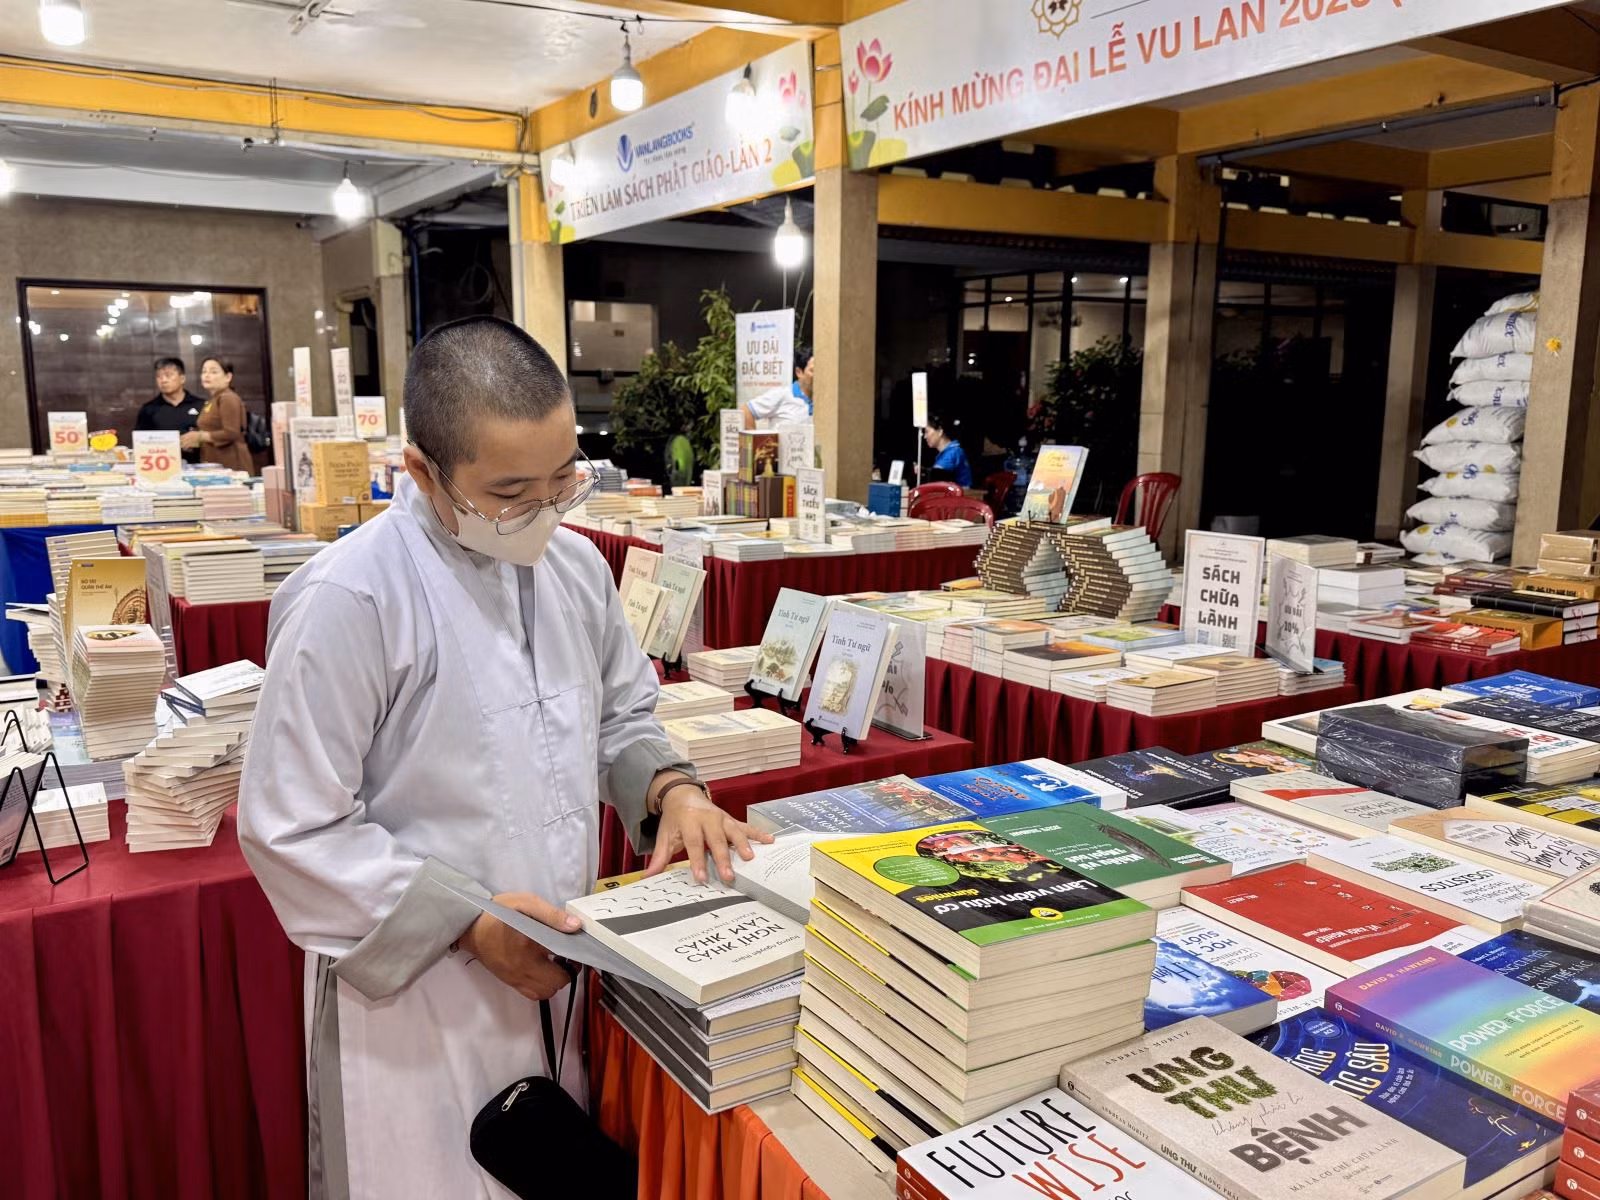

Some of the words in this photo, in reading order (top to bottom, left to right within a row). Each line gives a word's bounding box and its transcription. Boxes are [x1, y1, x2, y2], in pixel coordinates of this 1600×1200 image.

[894, 89, 944, 131] KÍNH
[951, 68, 1024, 115] MỪNG
[1033, 51, 1079, 94] ĐẠI
[1089, 21, 1127, 78] LỄ
[1136, 21, 1181, 64] VU
[1194, 0, 1266, 50] LAN
[624, 173, 654, 205] SÁCH
[763, 138, 773, 164] 2
[1202, 564, 1240, 584] SÁCH
[1200, 587, 1239, 608] CHỮA
[1198, 610, 1238, 631] LÀNH
[1054, 879, 1098, 896] Làm
[1419, 868, 1502, 893] LOGISTICS
[915, 887, 980, 903] dummies
[962, 894, 1003, 911] hữu
[1005, 885, 1053, 905] vườn
[933, 901, 961, 916] cơ
[728, 915, 771, 936] LÀM
[738, 922, 786, 948] NGHĨ
[1181, 930, 1220, 946] SUỐT
[1359, 973, 1387, 991] DAVID
[1399, 955, 1436, 976] HAWKINS
[1375, 1022, 1398, 1037] DAVID
[1448, 1018, 1511, 1052] POWER
[1509, 996, 1566, 1024] FORCE
[1104, 1047, 1150, 1066] ANDREAS
[1153, 1030, 1191, 1048] MORITZ
[1126, 1046, 1235, 1093] UNG
[1451, 1055, 1504, 1091] POWER
[1512, 1086, 1567, 1122] FORCE
[926, 1098, 1096, 1188] FUTURE
[1101, 1106, 1126, 1125] ANDREAS
[1127, 1122, 1149, 1140] MORITZ
[1160, 1143, 1180, 1163] UNG
[1180, 1157, 1199, 1174] THƯ
[1199, 1171, 1221, 1191] KHÔNG
[1229, 1105, 1369, 1173] BỆNH
[1375, 1137, 1400, 1154] LÀNH
[1012, 1133, 1146, 1200] WISE
